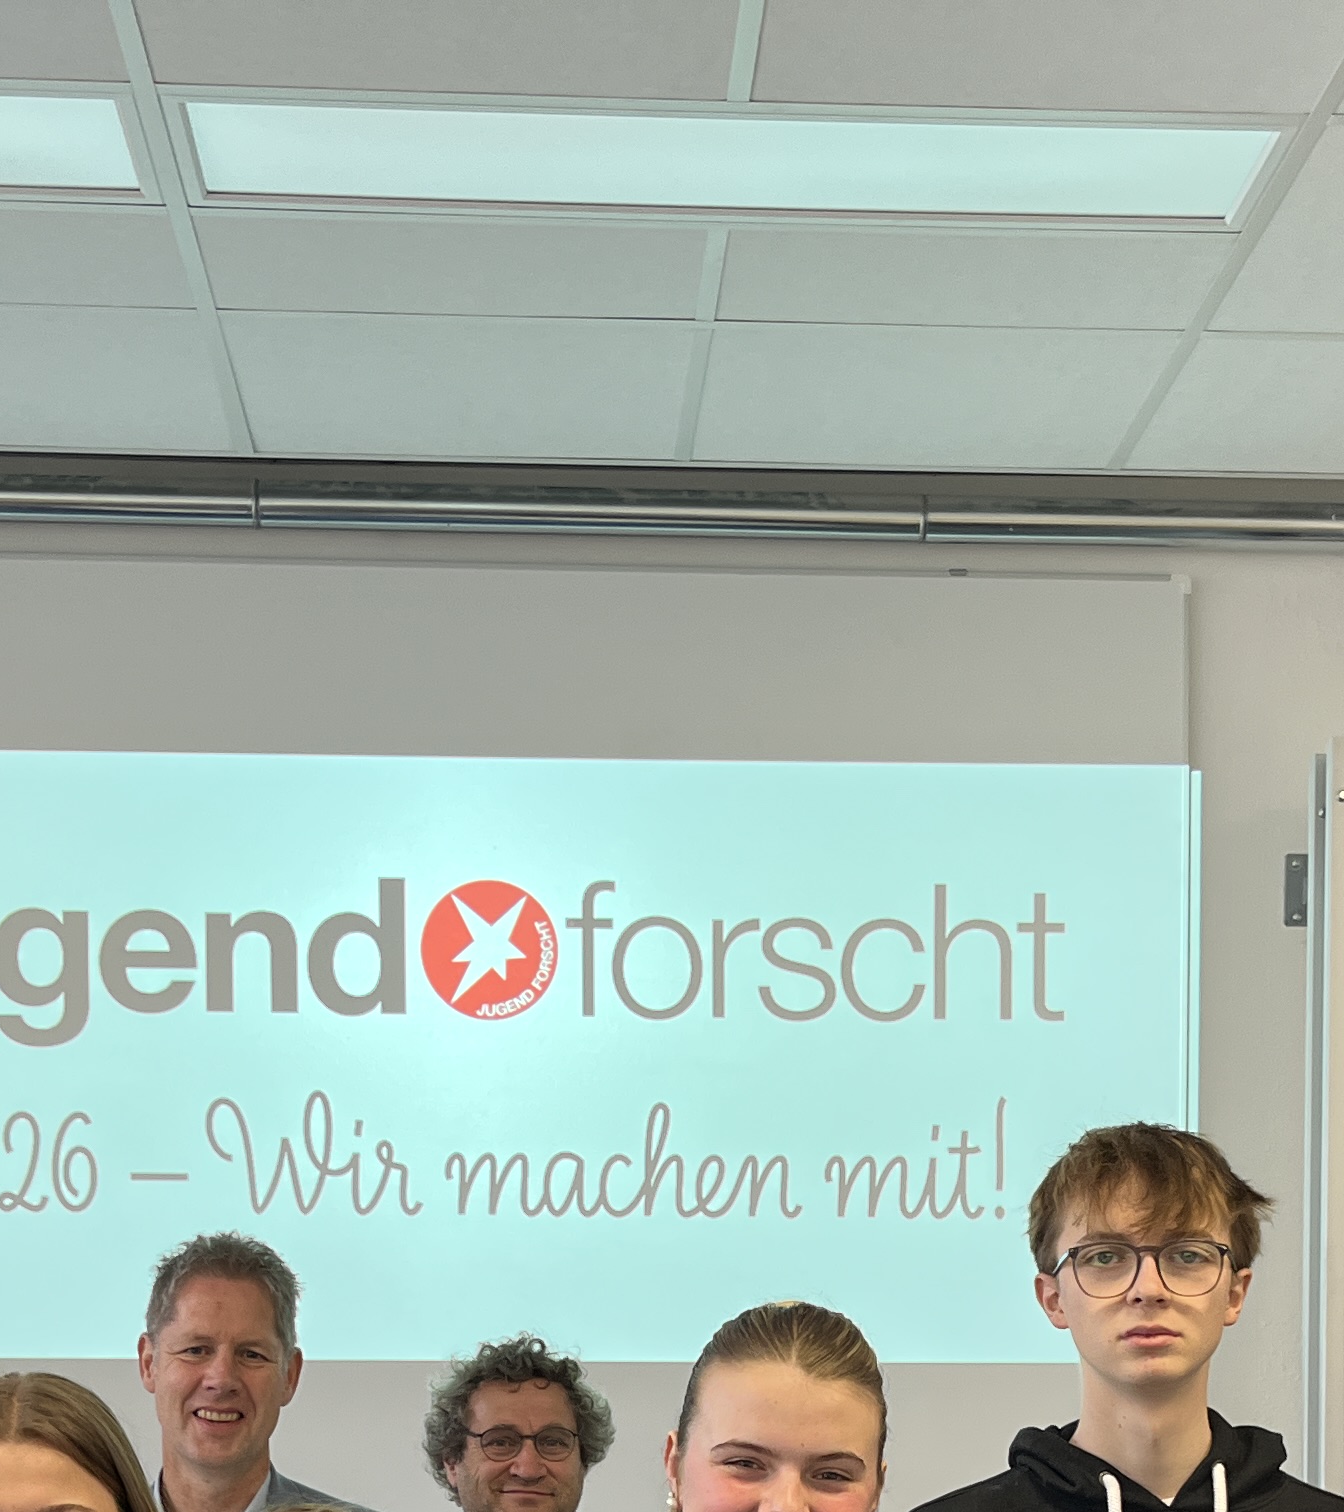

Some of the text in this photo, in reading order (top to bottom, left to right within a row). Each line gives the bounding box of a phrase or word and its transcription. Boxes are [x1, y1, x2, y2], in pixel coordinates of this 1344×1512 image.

[476, 921, 554, 1016] JUGEND FORSCHT
[565, 880, 1066, 1022] forscht
[206, 1090, 423, 1215] Wir
[445, 1102, 802, 1219] machen
[825, 1096, 1007, 1219] mit!
